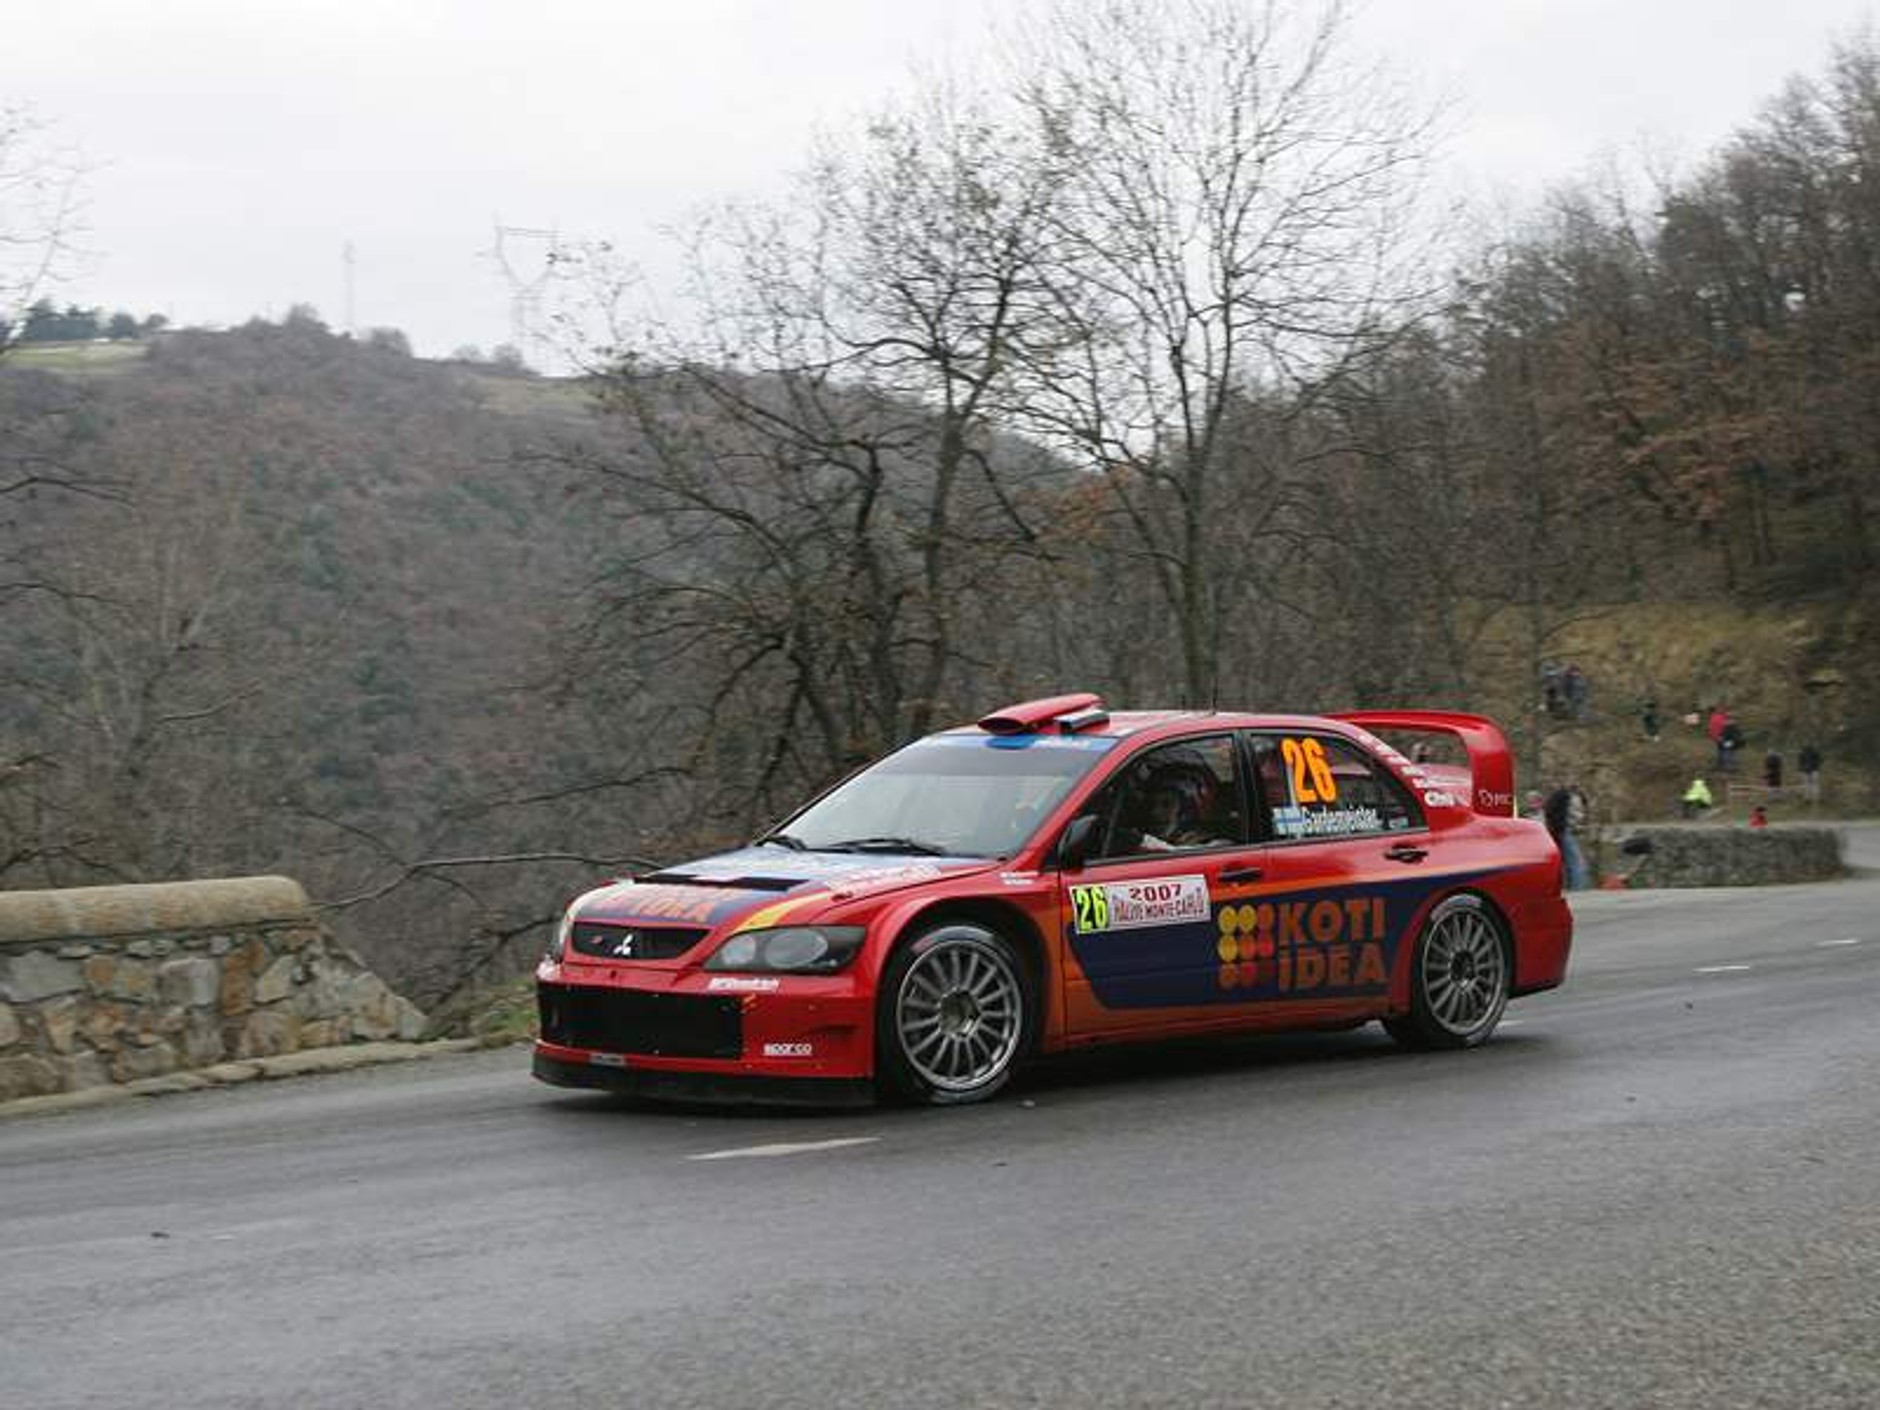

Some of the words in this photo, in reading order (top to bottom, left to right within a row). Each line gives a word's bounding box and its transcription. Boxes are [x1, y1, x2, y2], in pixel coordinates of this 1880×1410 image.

[1281, 737, 1337, 804] 26
[1076, 885, 1108, 932] 26
[1129, 883, 1181, 901] 2007
[1278, 898, 1386, 945] KOTI
[1278, 942, 1389, 992] IDEA
